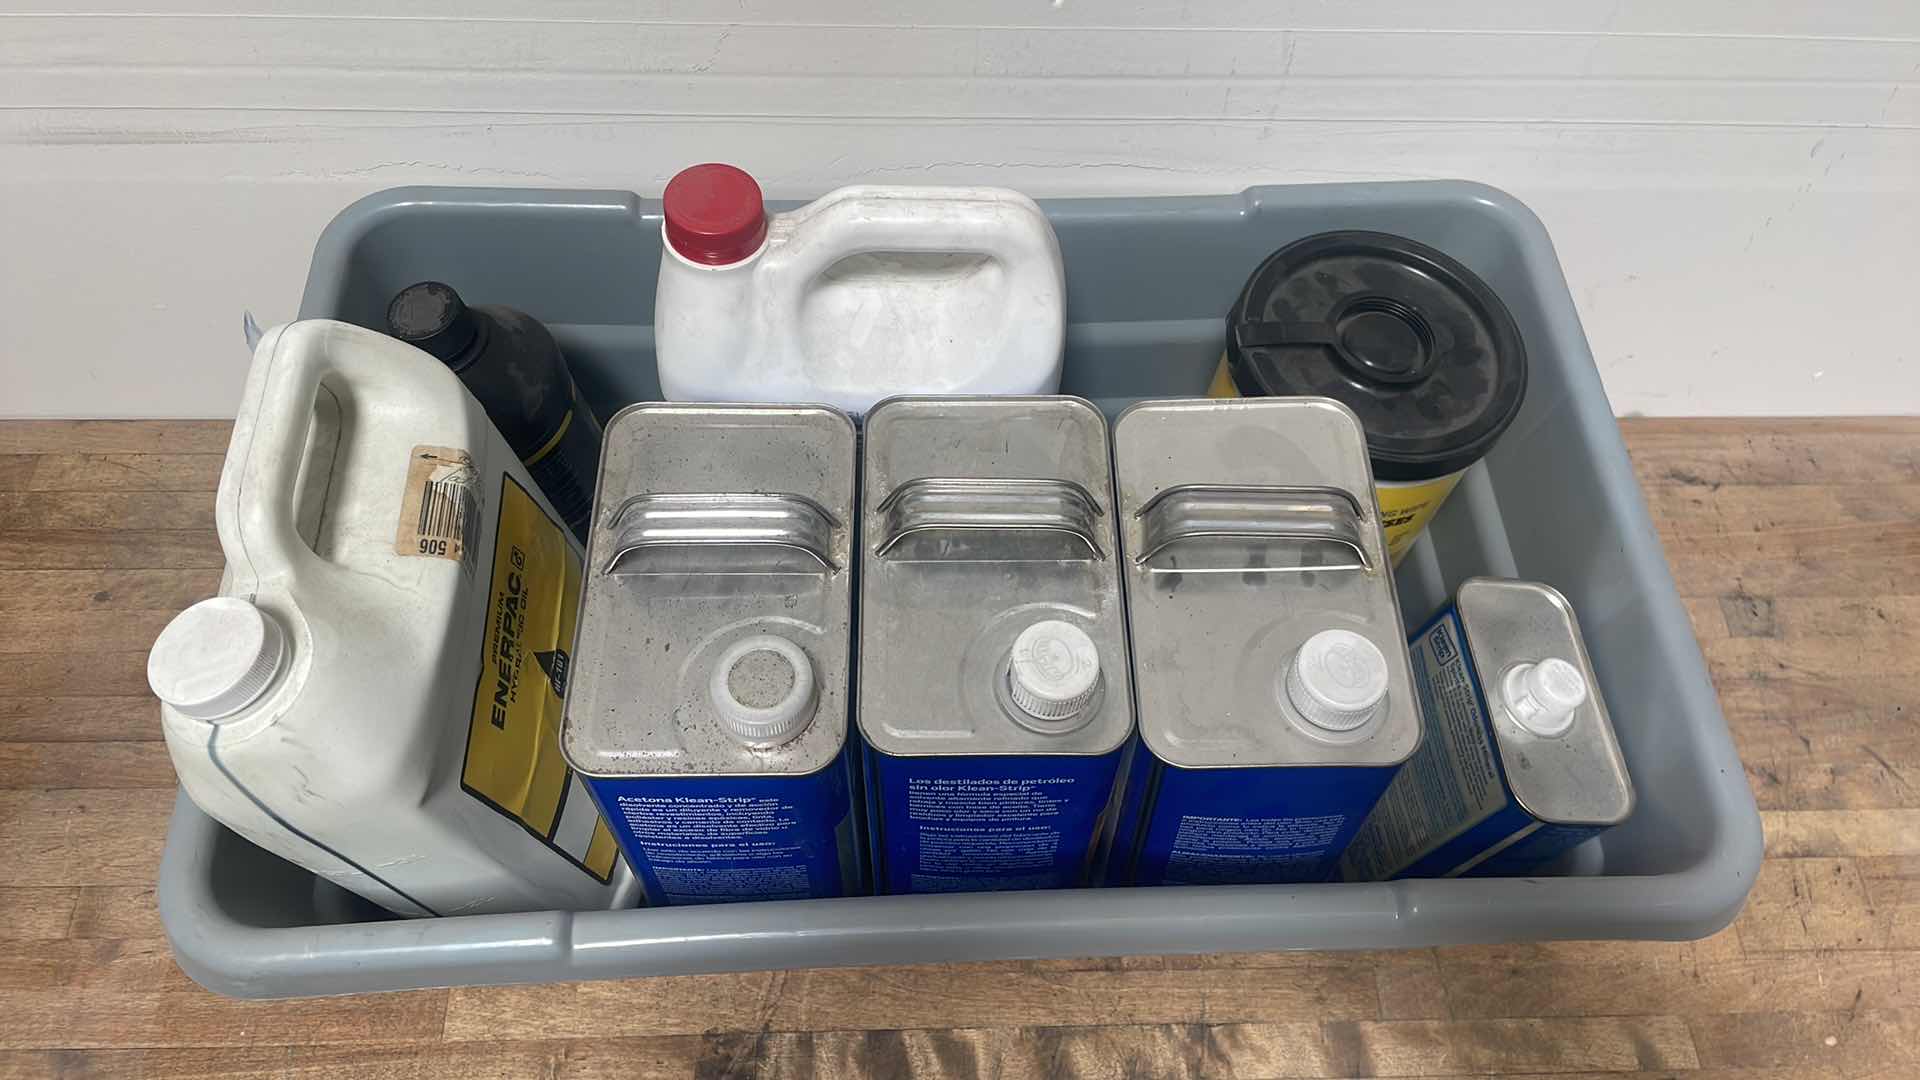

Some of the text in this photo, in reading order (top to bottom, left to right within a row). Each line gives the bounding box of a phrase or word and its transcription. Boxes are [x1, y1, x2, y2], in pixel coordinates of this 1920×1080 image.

[419, 541, 446, 556] 506
[492, 592, 505, 667] PREMIUM
[492, 571, 522, 730] ENERPAC
[510, 586, 529, 704] HYDRAIC OIL
[1022, 777, 1075, 785] petróleo
